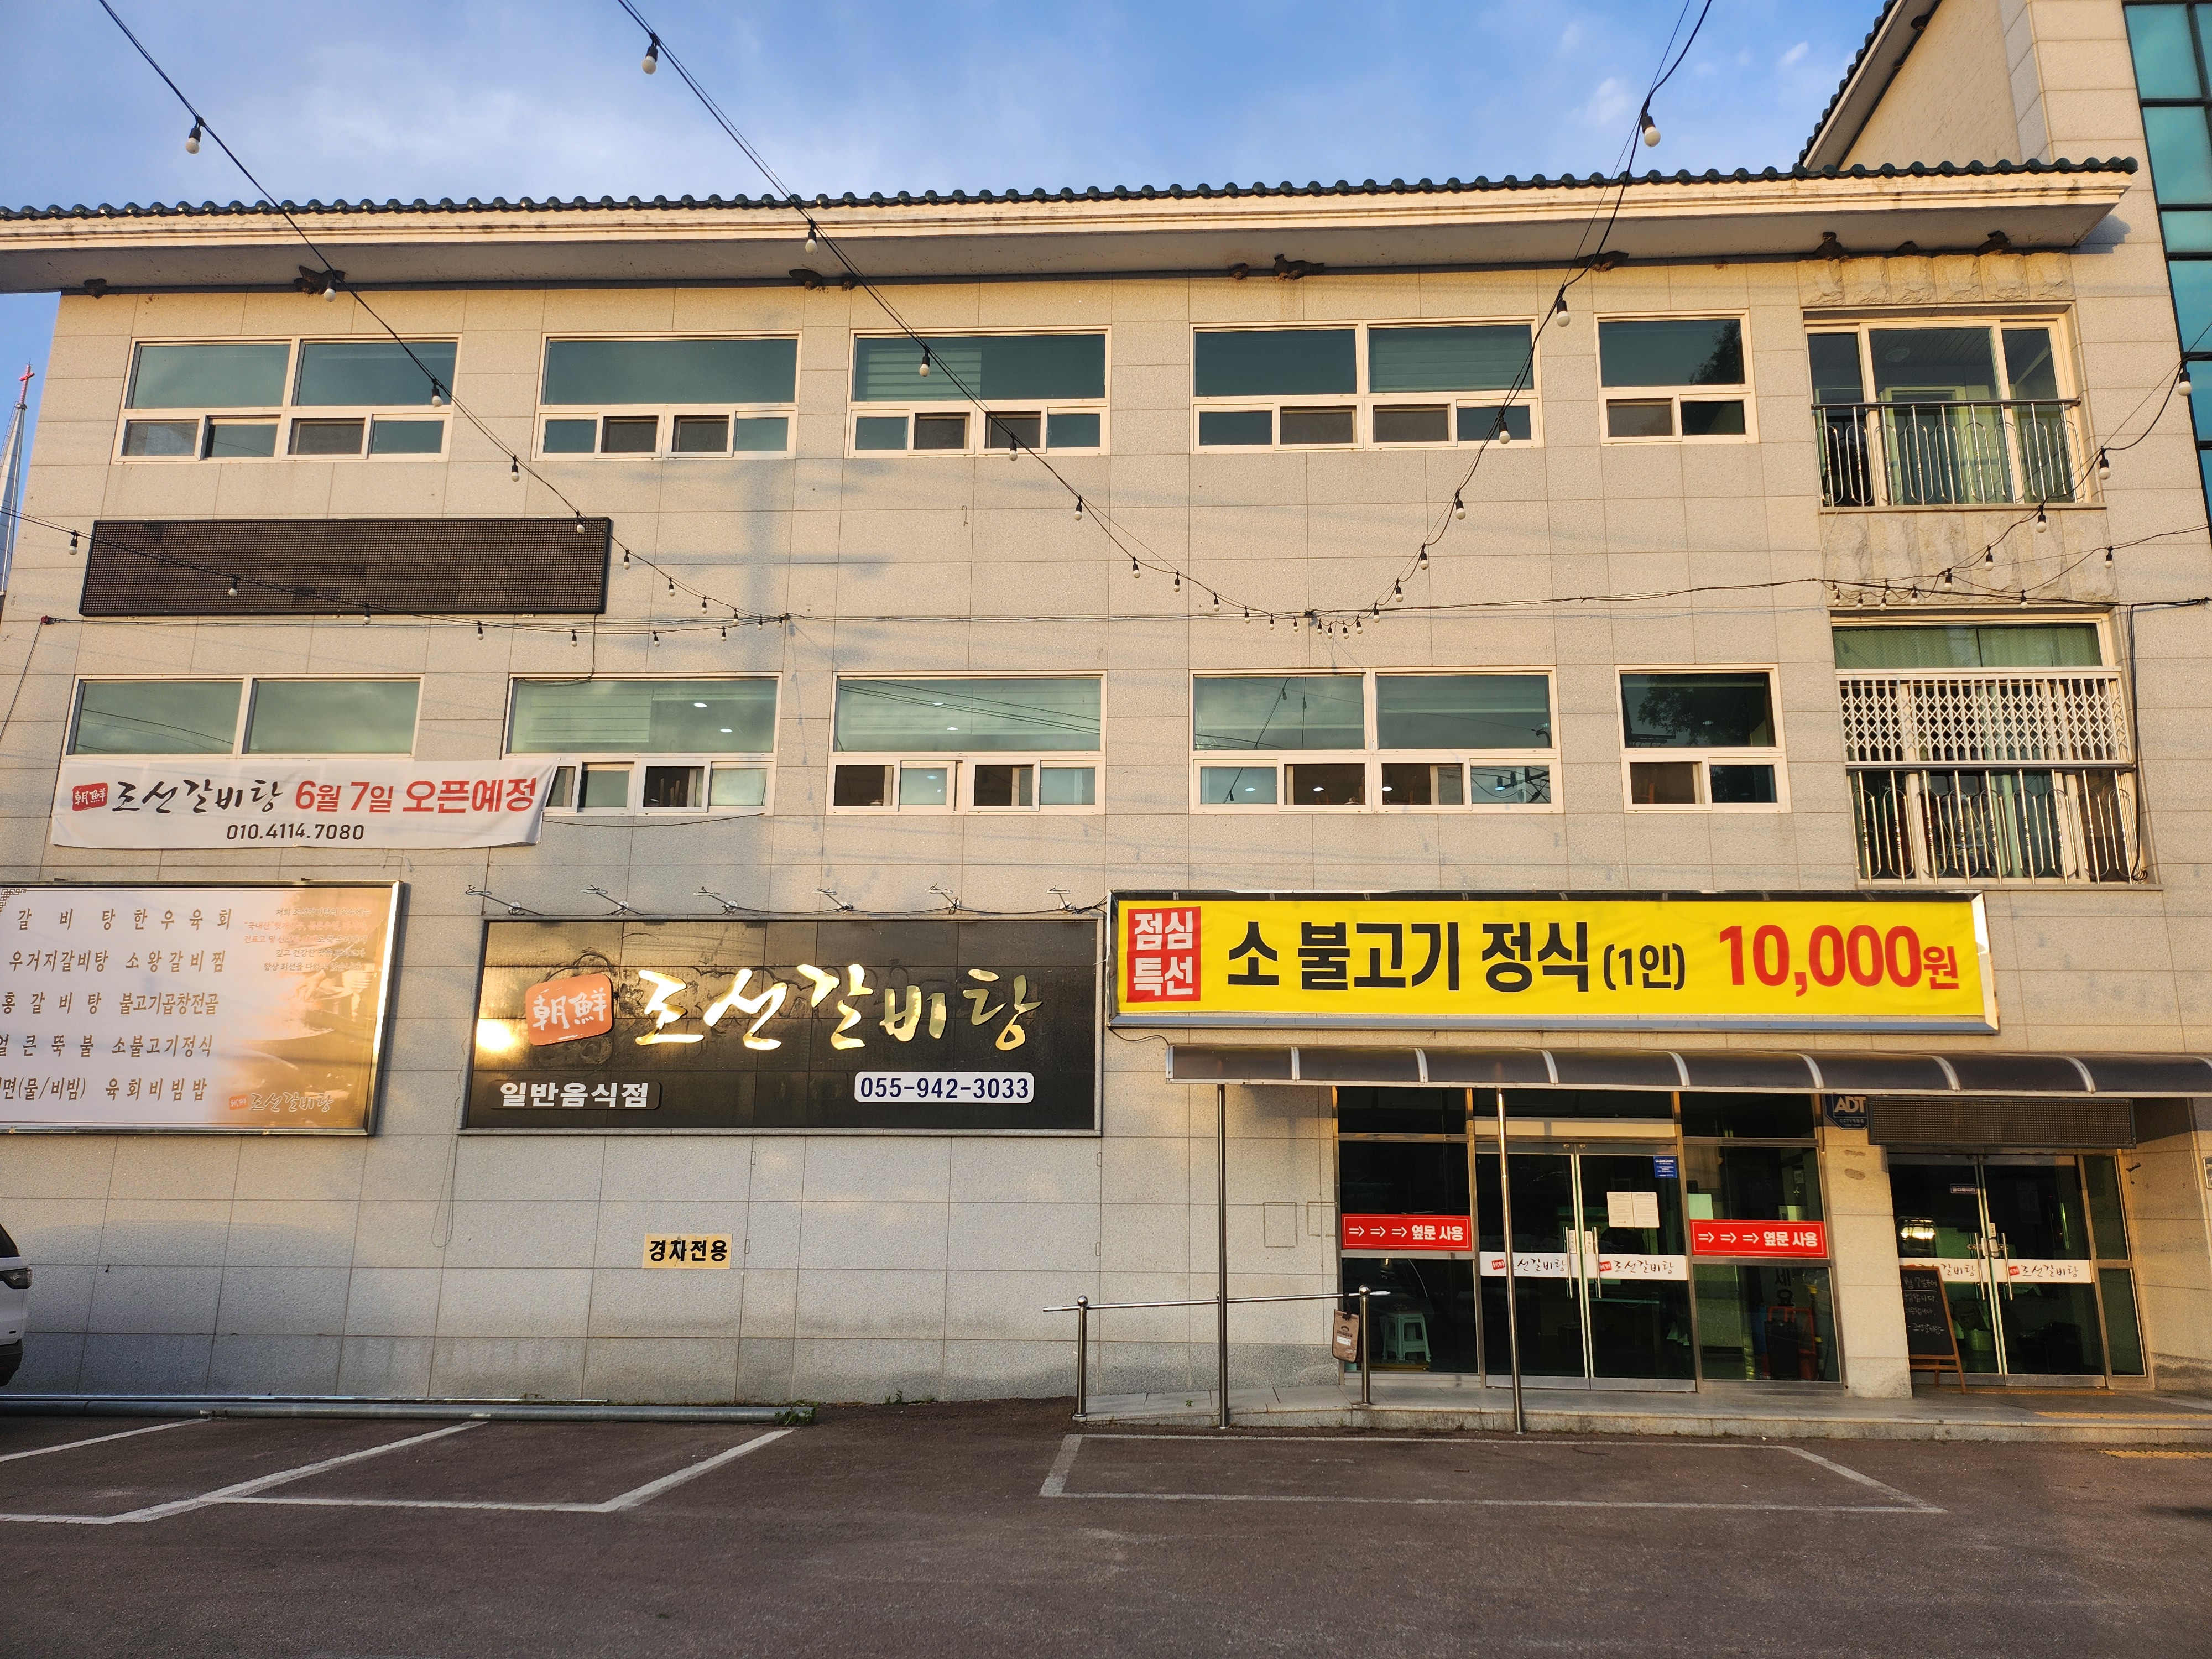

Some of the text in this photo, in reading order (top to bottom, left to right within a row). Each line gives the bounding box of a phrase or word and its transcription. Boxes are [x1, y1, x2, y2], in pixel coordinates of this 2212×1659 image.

[74, 786, 107, 805] 朝鮮
[112, 777, 536, 813] 조선갈비탕 6월 7일 오픈예정
[226, 823, 364, 840] 010.4114.7080
[1134, 911, 1193, 950] 점심
[9, 950, 109, 972] 우거지갈비탕
[1228, 921, 1959, 997] 소 불고기 정식 (1인) 10,000원
[1133, 956, 1193, 996] 특선
[119, 992, 219, 1015] 불고기곱창전골
[531, 987, 608, 1031] 朝鮮
[635, 963, 1043, 1051] 조선갈비탕
[112, 1034, 212, 1057] 소불고기정식
[0, 1076, 86, 1101] 면(물/비빔)
[500, 1082, 648, 1108] 일반음식점
[860, 1077, 1029, 1099] 055-942-3033
[248, 1092, 334, 1113] 조선갈비탕
[1834, 1095, 1866, 1113] ADT
[1411, 1224, 1464, 1241] 옆문 사용
[1763, 1230, 1818, 1248] 옆문 사용
[649, 1239, 728, 1262] 경차전용
[1512, 1257, 1567, 1272] 선갈비탕
[1614, 1259, 1674, 1275] 조선갈비탕
[2021, 1264, 2079, 1277] 조선갈비탕
